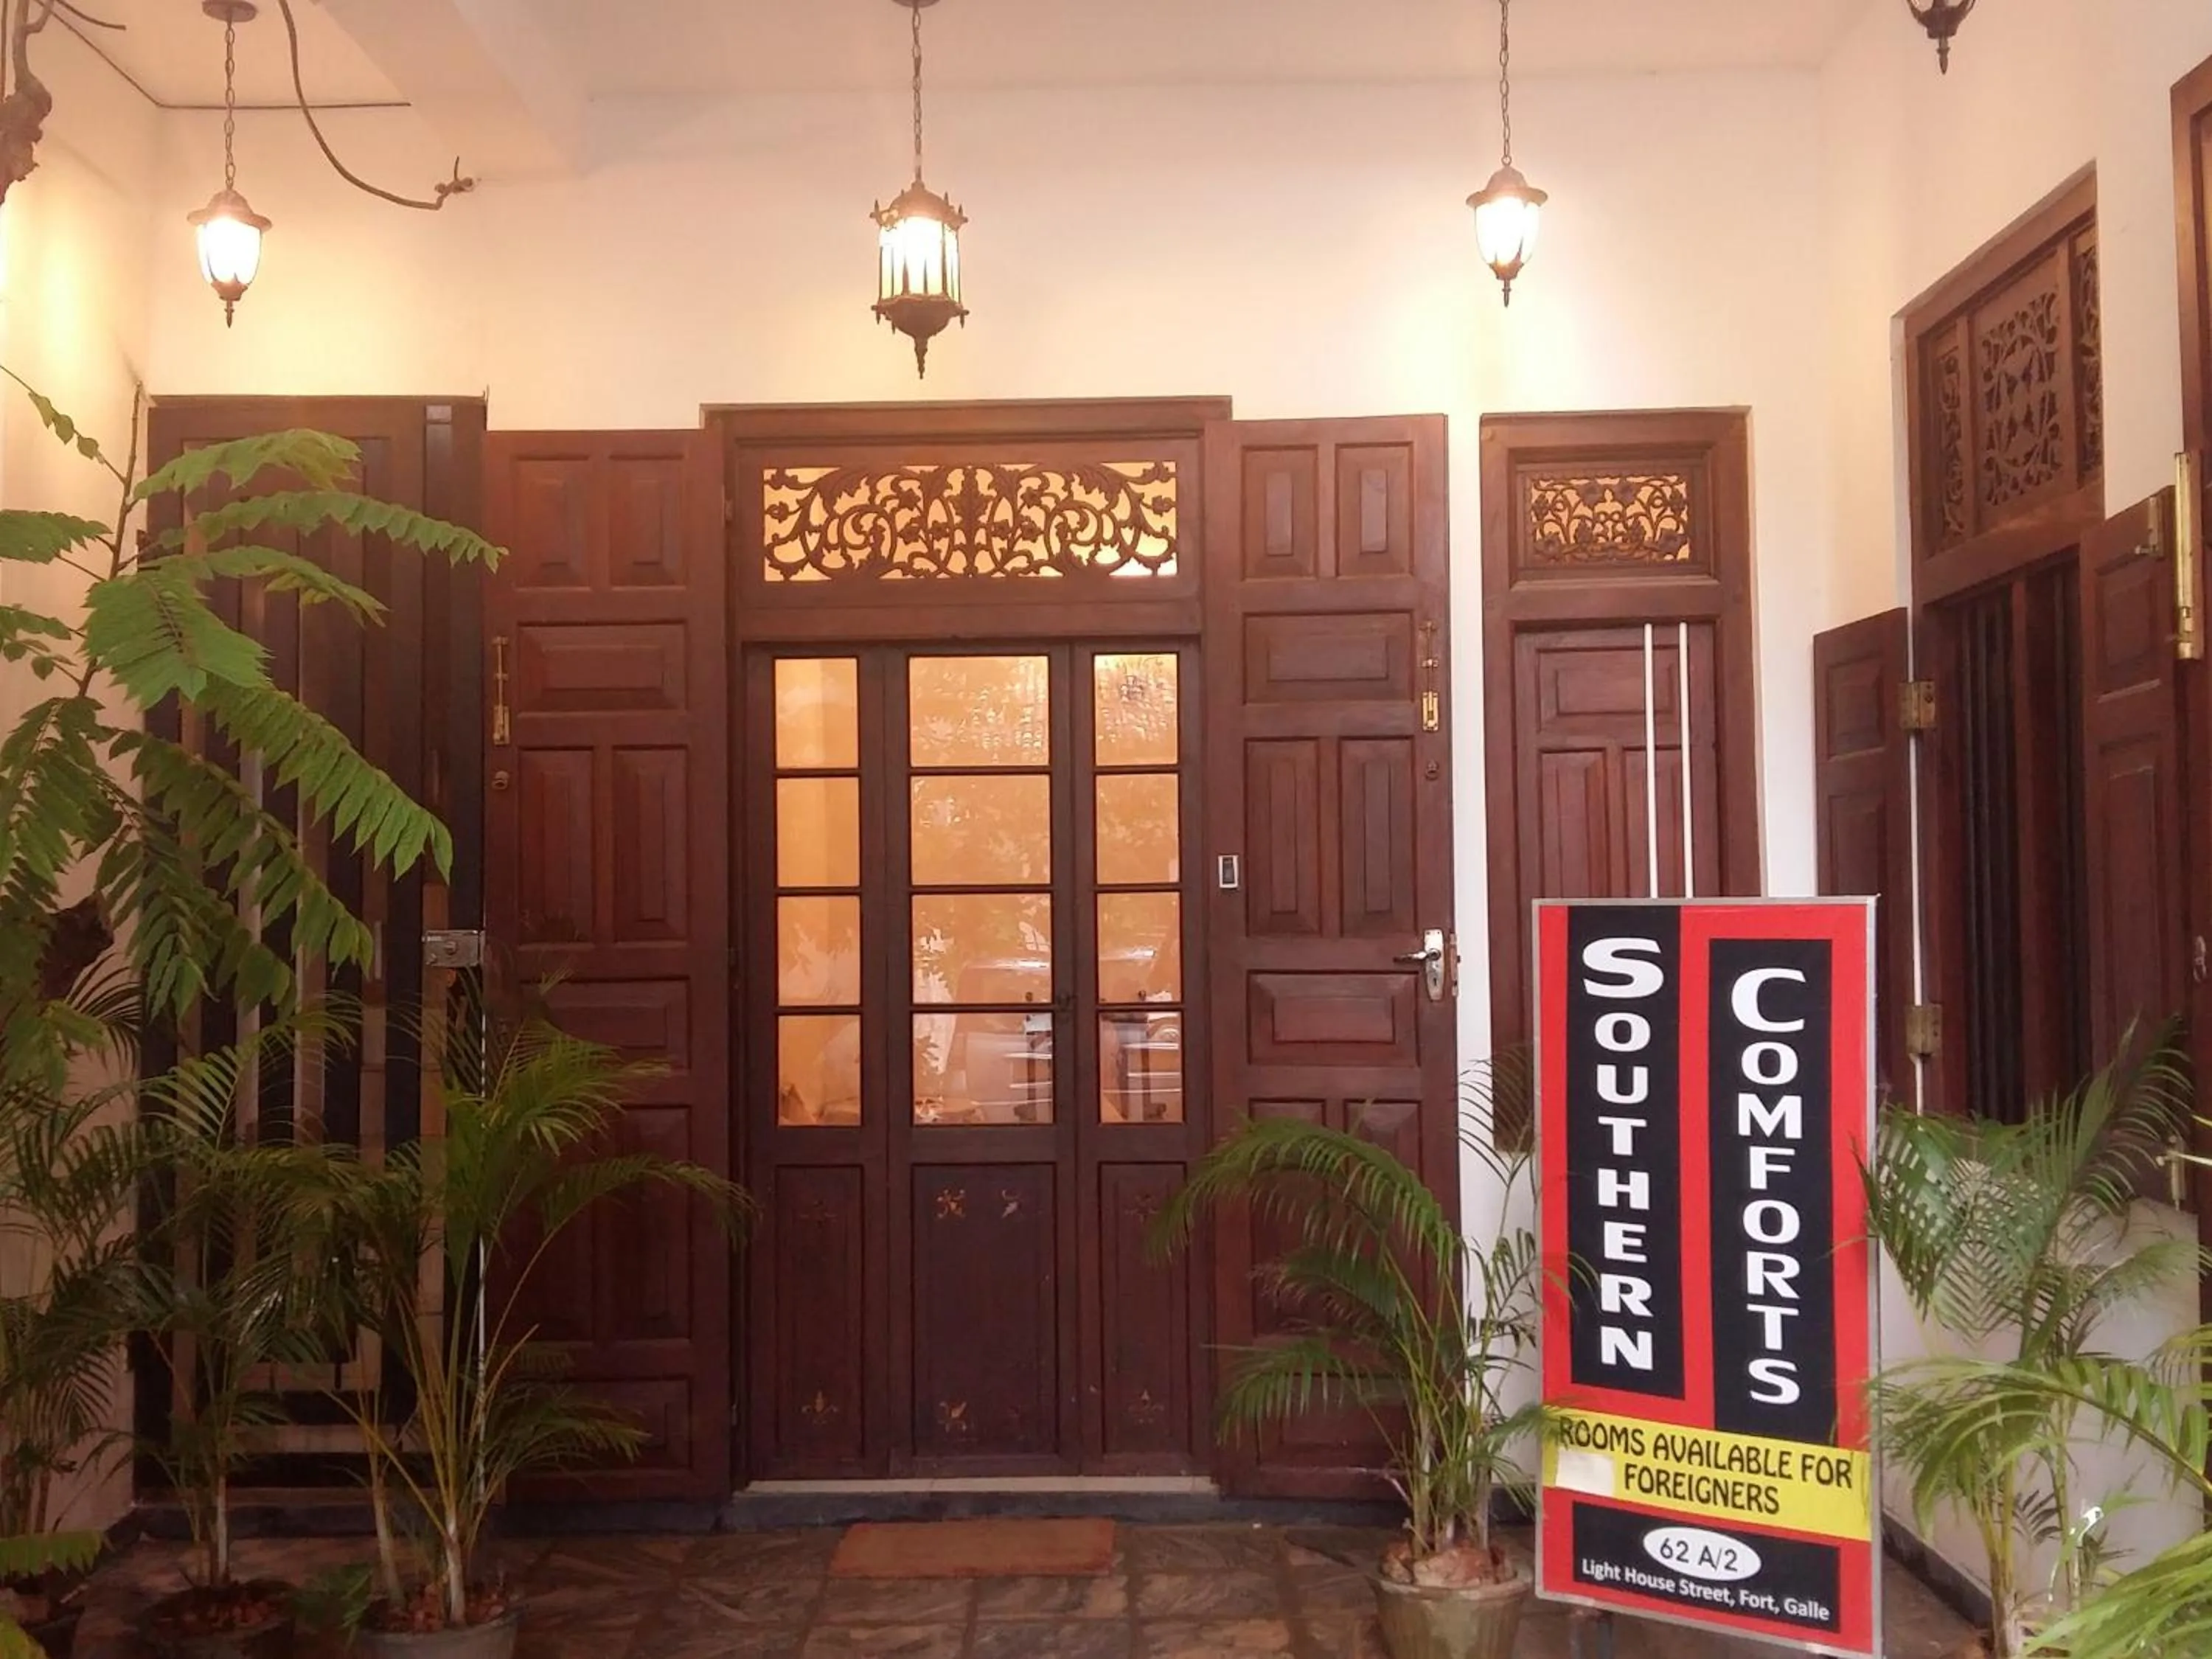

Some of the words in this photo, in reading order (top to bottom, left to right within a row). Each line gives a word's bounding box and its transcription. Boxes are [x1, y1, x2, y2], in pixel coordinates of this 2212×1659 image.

[1582, 937, 1664, 1371] SOUTHERN
[1731, 967, 1806, 1405] COMFORTS
[1558, 1416, 1645, 1456] ROOMS
[1652, 1433, 1792, 1479] AVAILABLE
[1801, 1454, 1853, 1489] FOR
[1624, 1463, 1780, 1515] FOREIGNERS
[1659, 1537, 1690, 1563] 62
[1698, 1545, 1738, 1572] A/2
[1582, 1558, 1621, 1582] Light
[1625, 1566, 1676, 1594] House
[1679, 1578, 1735, 1607] Street,
[1739, 1592, 1780, 1615] Fort,
[1784, 1597, 1829, 1621] Galle
